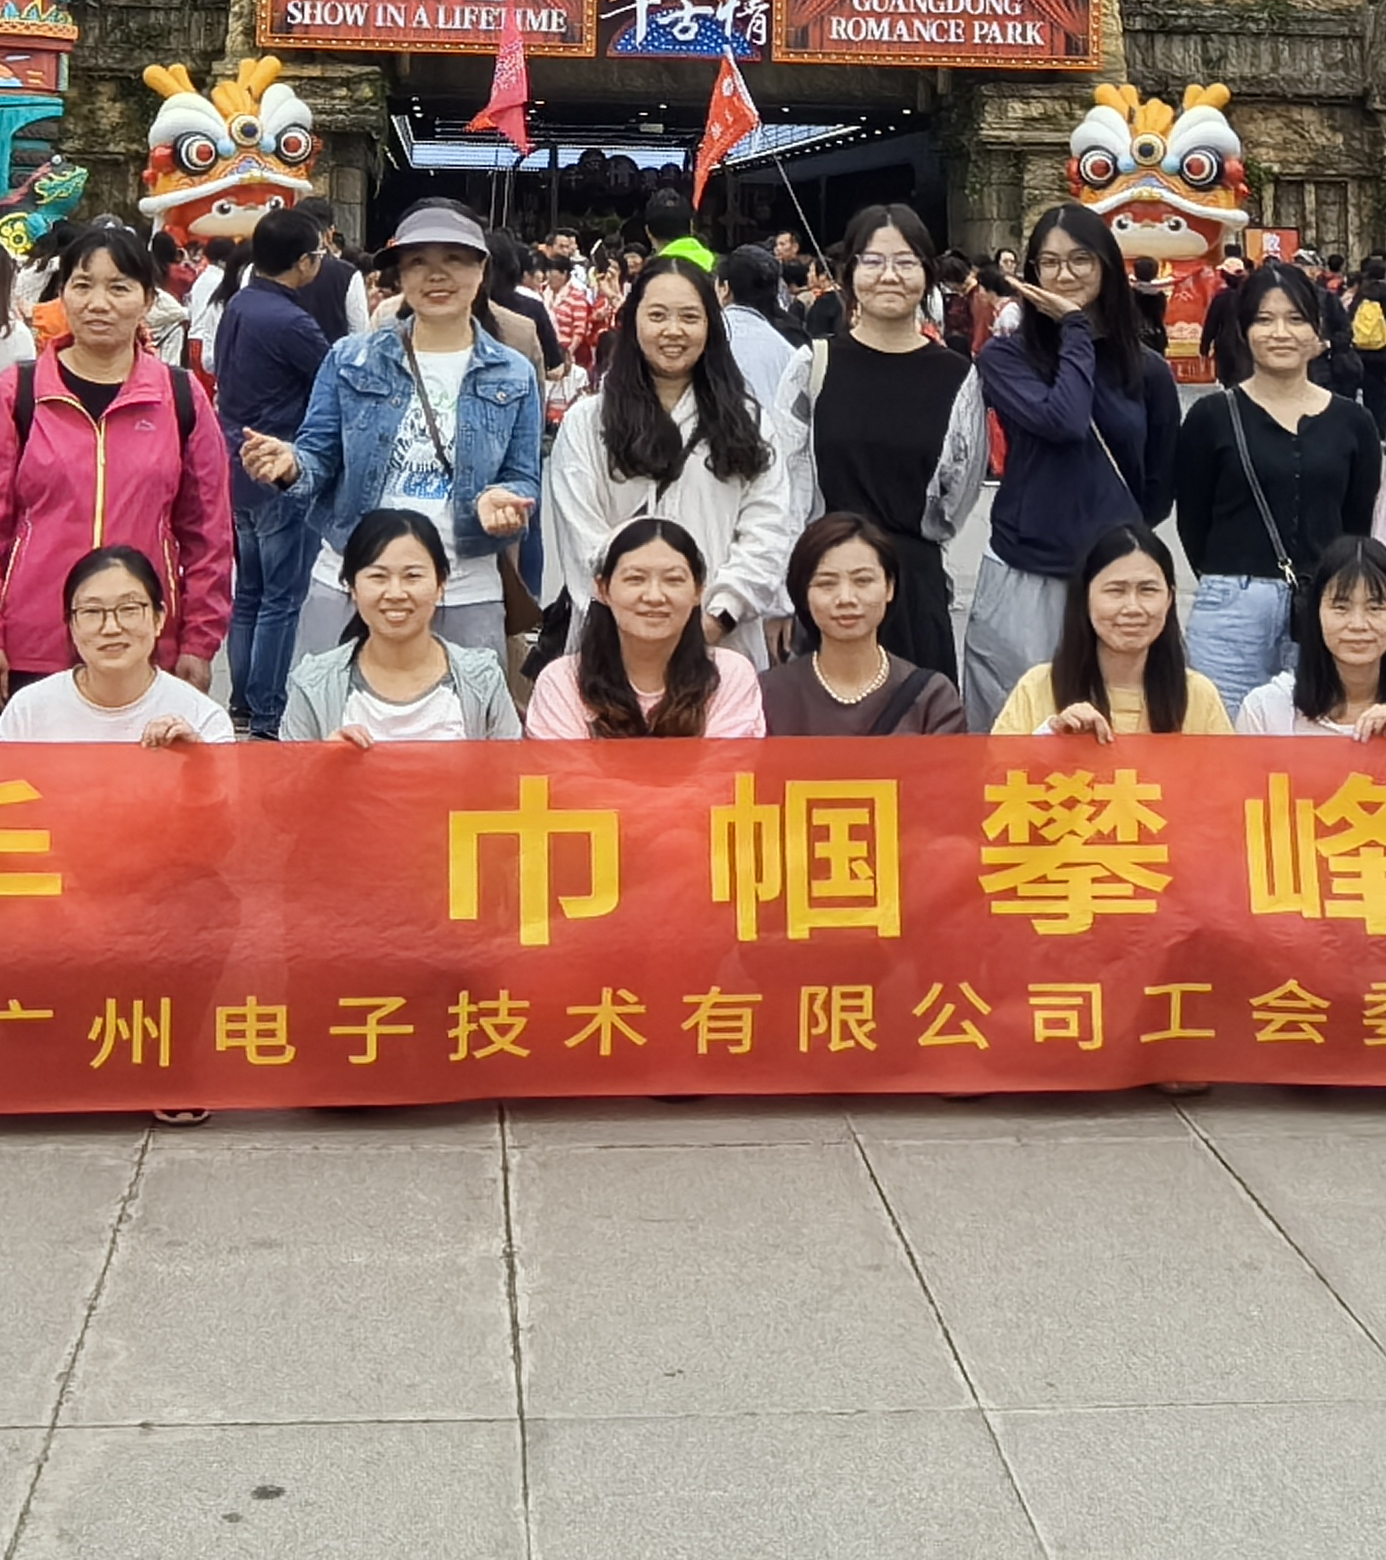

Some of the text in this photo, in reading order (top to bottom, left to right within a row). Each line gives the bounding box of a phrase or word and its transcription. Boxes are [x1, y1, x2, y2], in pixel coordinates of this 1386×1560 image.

[287, 0, 368, 26] SHOW
[375, 2, 407, 28] IN
[412, 4, 431, 28] A
[829, 16, 1045, 46] ROMANCE PARK
